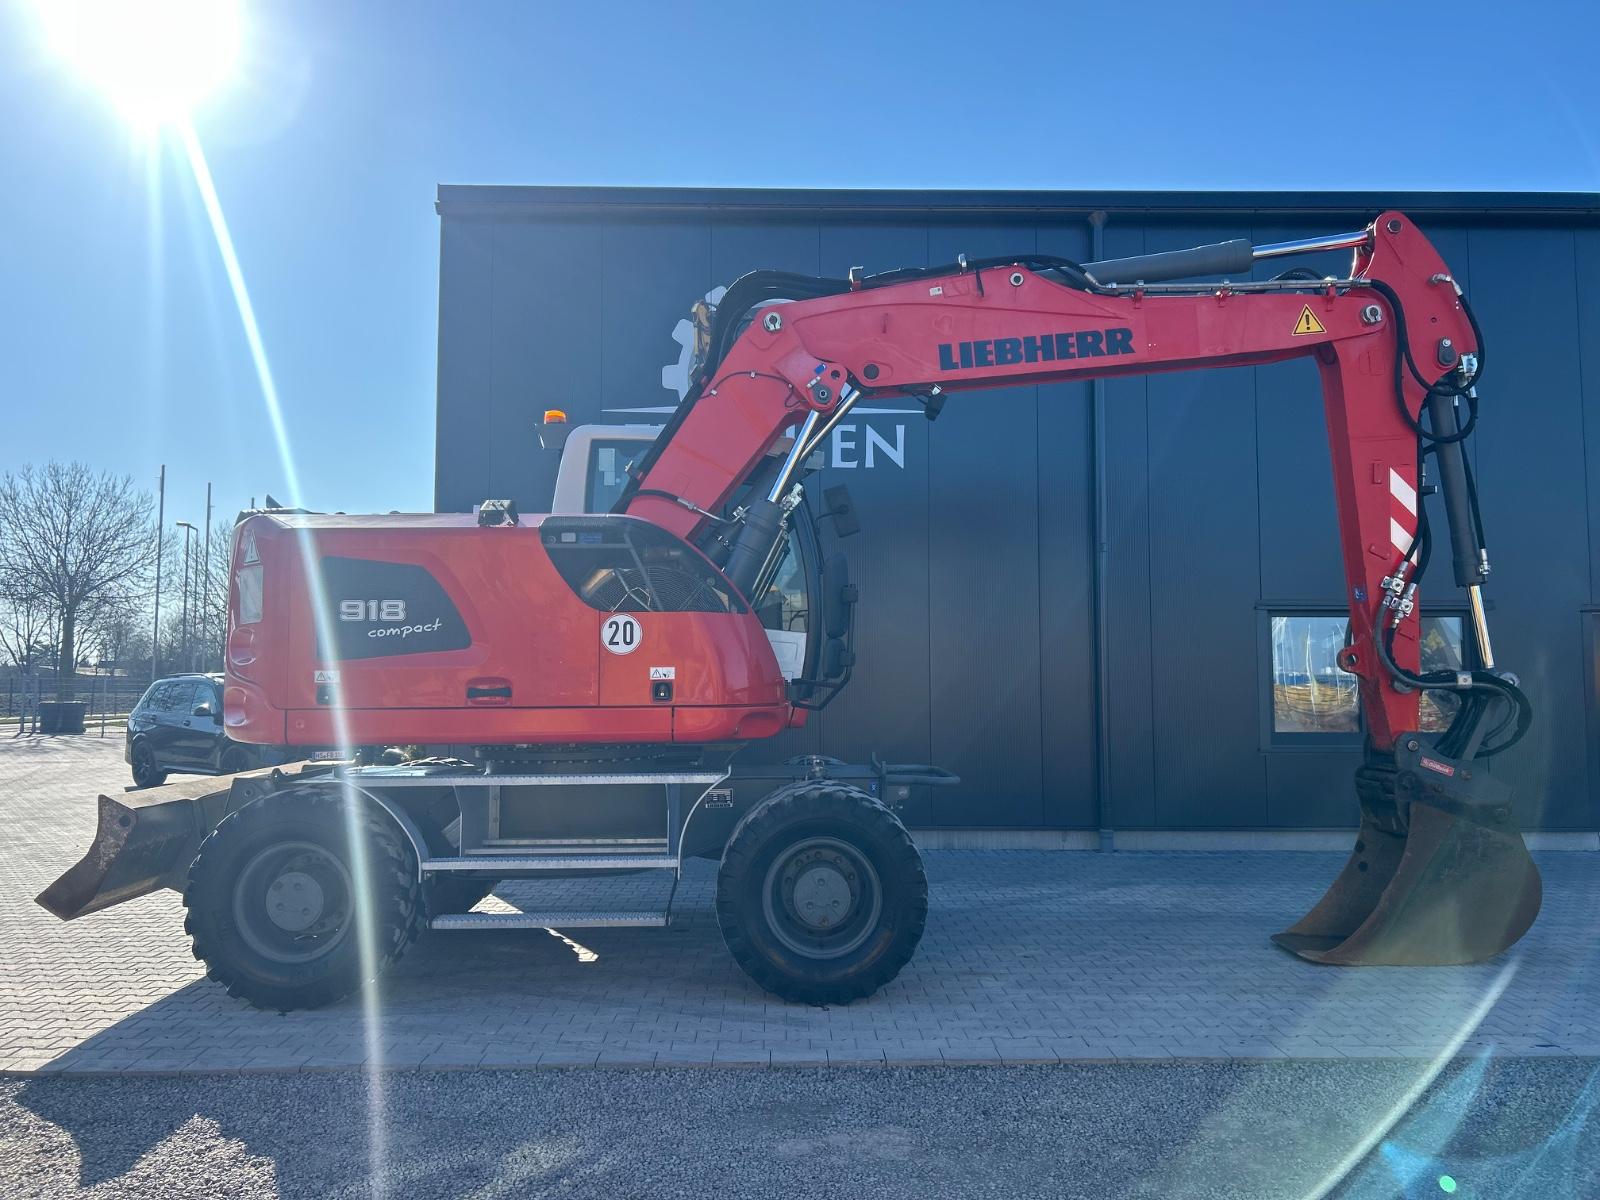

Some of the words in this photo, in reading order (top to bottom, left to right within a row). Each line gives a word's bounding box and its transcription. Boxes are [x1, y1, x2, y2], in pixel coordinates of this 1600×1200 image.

[938, 327, 1136, 371] LIEBHERR
[786, 424, 905, 469] EN
[340, 599, 406, 621] 918
[367, 617, 442, 638] compact
[608, 620, 634, 646] 20
